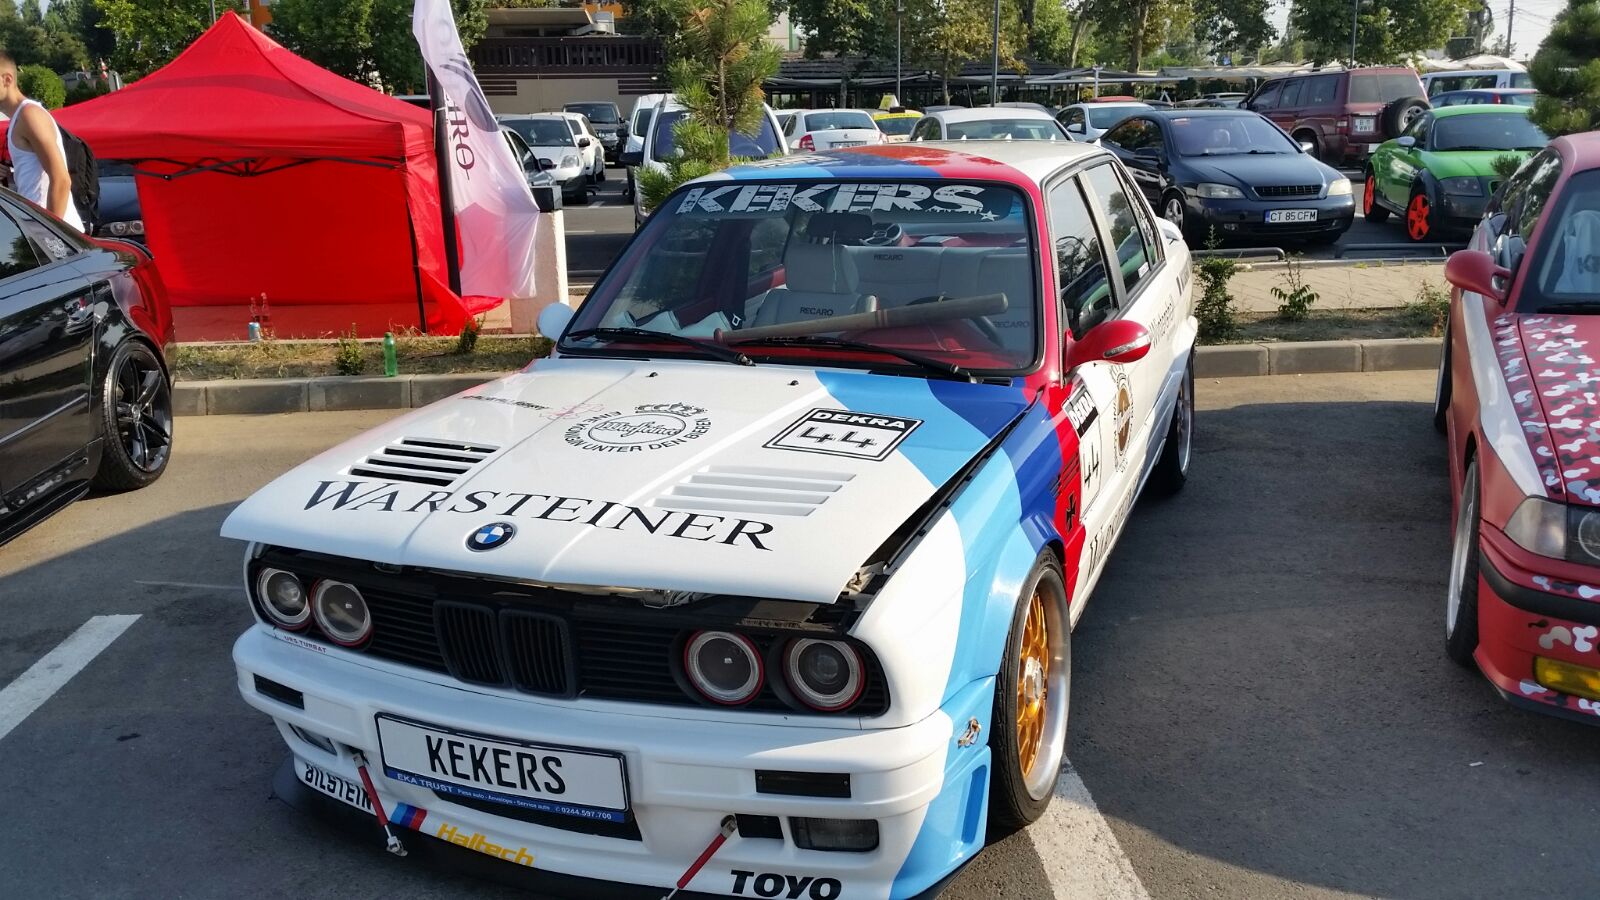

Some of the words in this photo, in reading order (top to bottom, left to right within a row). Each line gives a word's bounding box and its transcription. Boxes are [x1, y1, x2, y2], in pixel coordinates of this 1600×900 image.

[675, 184, 986, 214] KEKERS
[1270, 212, 1281, 221] CT
[1285, 211, 1296, 221] 85
[1297, 211, 1316, 221] CFM
[800, 306, 834, 316] RECARO
[813, 411, 906, 429] DEKRA
[582, 445, 642, 453] UNTER
[649, 438, 687, 450] DEN
[800, 427, 877, 448] 44
[1082, 442, 1100, 489] 44
[303, 480, 774, 551] WARSTEINER
[426, 734, 566, 795] KEKERS
[304, 763, 372, 810] BILSTEIN
[397, 772, 418, 785] EKA
[419, 779, 453, 793] TRUST
[437, 823, 535, 867] Haltech
[731, 869, 842, 900] TOYO
